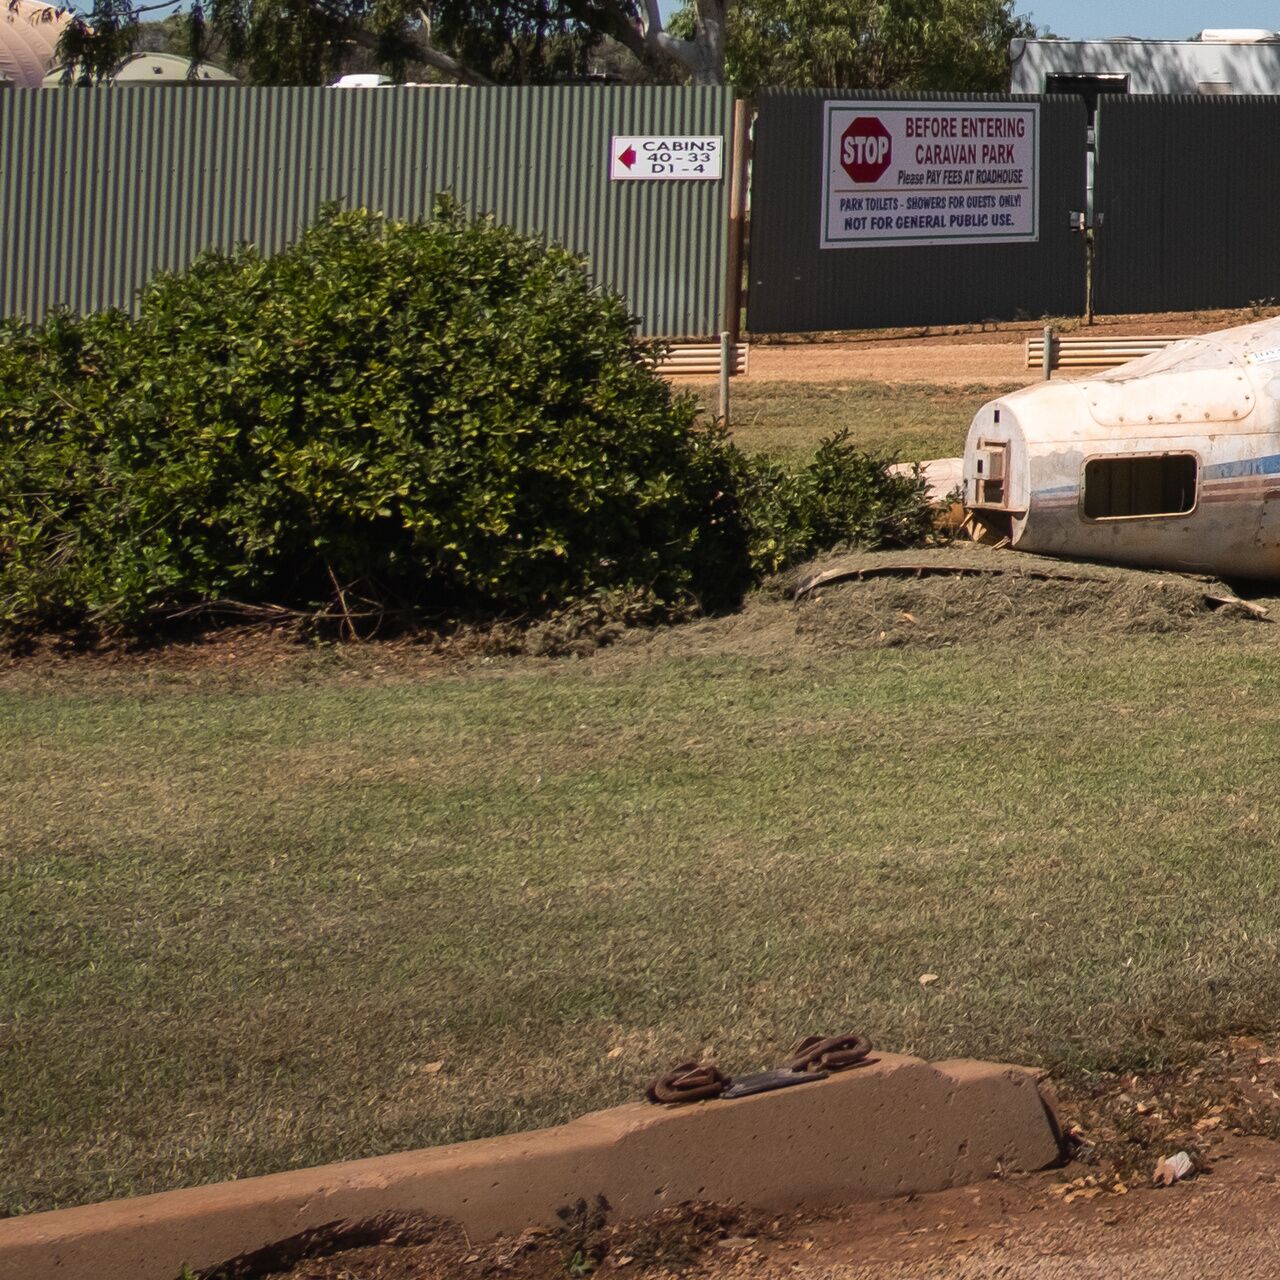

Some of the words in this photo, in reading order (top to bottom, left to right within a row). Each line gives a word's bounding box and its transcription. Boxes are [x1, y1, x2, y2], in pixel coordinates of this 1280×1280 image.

[906, 117, 958, 138] BEFORE
[961, 117, 1025, 138] ENTERING
[643, 141, 716, 151] CABINS
[843, 136, 889, 165] STOP
[915, 144, 977, 165] CARAVAN
[982, 144, 1015, 164] PARK
[647, 153, 671, 162] 40
[688, 153, 711, 162] 33
[651, 164, 674, 173] D1
[693, 164, 705, 173] 4
[898, 170, 925, 185] Please
[925, 170, 941, 185] PAY
[943, 170, 963, 185] FEES
[964, 170, 975, 184] AT
[975, 169, 1024, 184] ROADHOUSE
[840, 198, 864, 211] PARK
[865, 197, 899, 210] TOILETS
[907, 196, 946, 210] SHOWERS
[949, 196, 965, 209] FOR
[966, 195, 996, 208] GUESTS
[999, 194, 1021, 208] ONLY!
[844, 217, 868, 231] NOT
[870, 217, 893, 230] FOR
[896, 215, 946, 229] GENERAL
[950, 214, 988, 228] PUBLIC
[991, 214, 1015, 227] USE.
